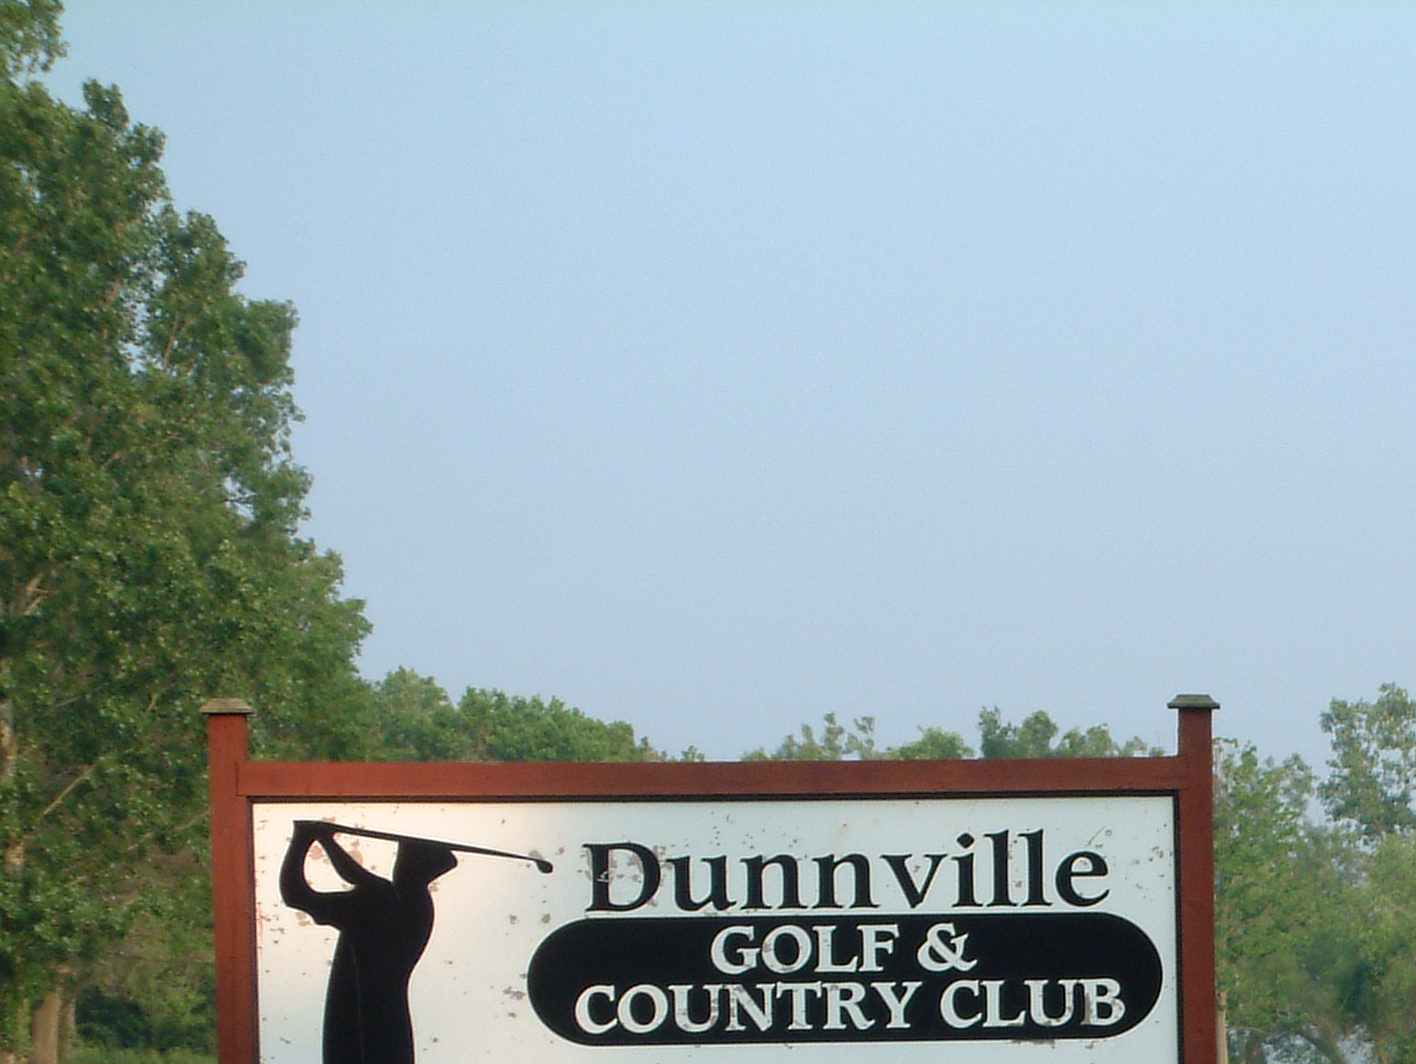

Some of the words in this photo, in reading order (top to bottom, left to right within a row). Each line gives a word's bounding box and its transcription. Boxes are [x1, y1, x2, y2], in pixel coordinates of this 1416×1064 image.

[582, 829, 1110, 913] Dunnville
[711, 923, 900, 975] GOLF
[917, 922, 978, 973] &
[575, 981, 922, 1035] COUNTRY
[940, 978, 1126, 1029] CLUB
